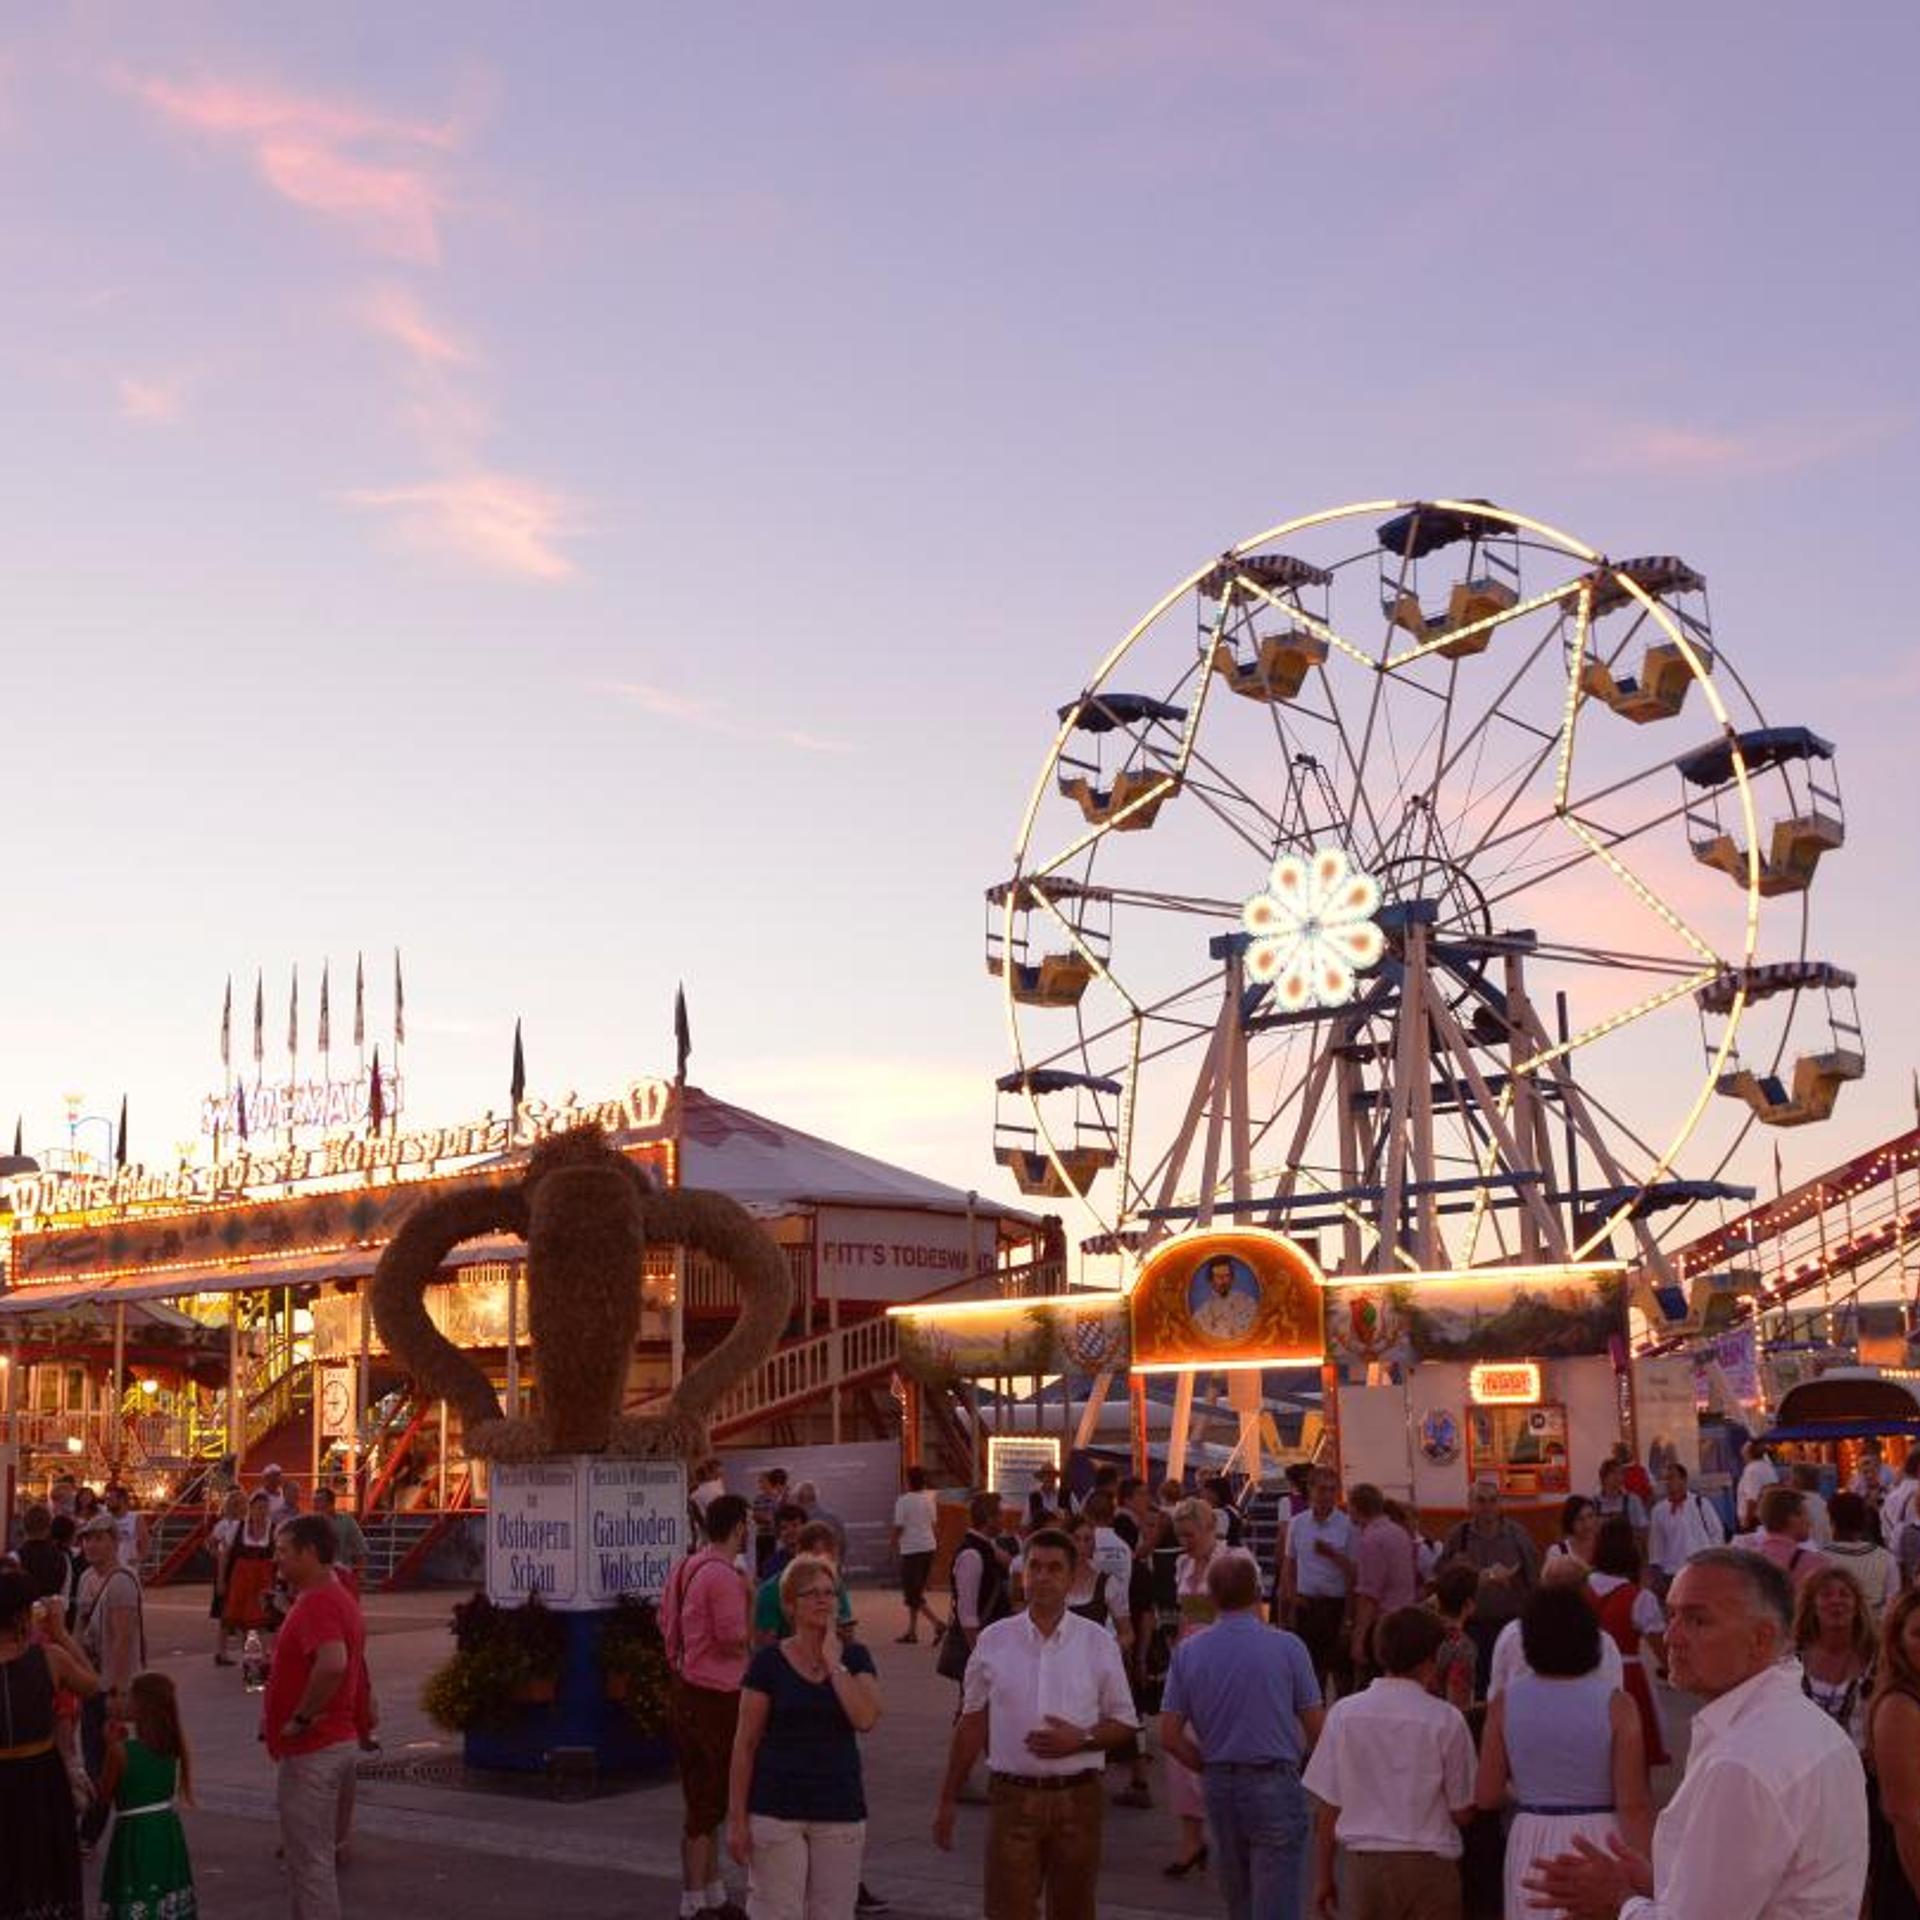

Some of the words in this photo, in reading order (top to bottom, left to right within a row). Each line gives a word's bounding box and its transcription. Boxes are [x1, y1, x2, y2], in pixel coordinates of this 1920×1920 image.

[497, 1511, 571, 1556] Ostbayern
[593, 1509, 676, 1547] Gauboden
[510, 1552, 556, 1593] Schau
